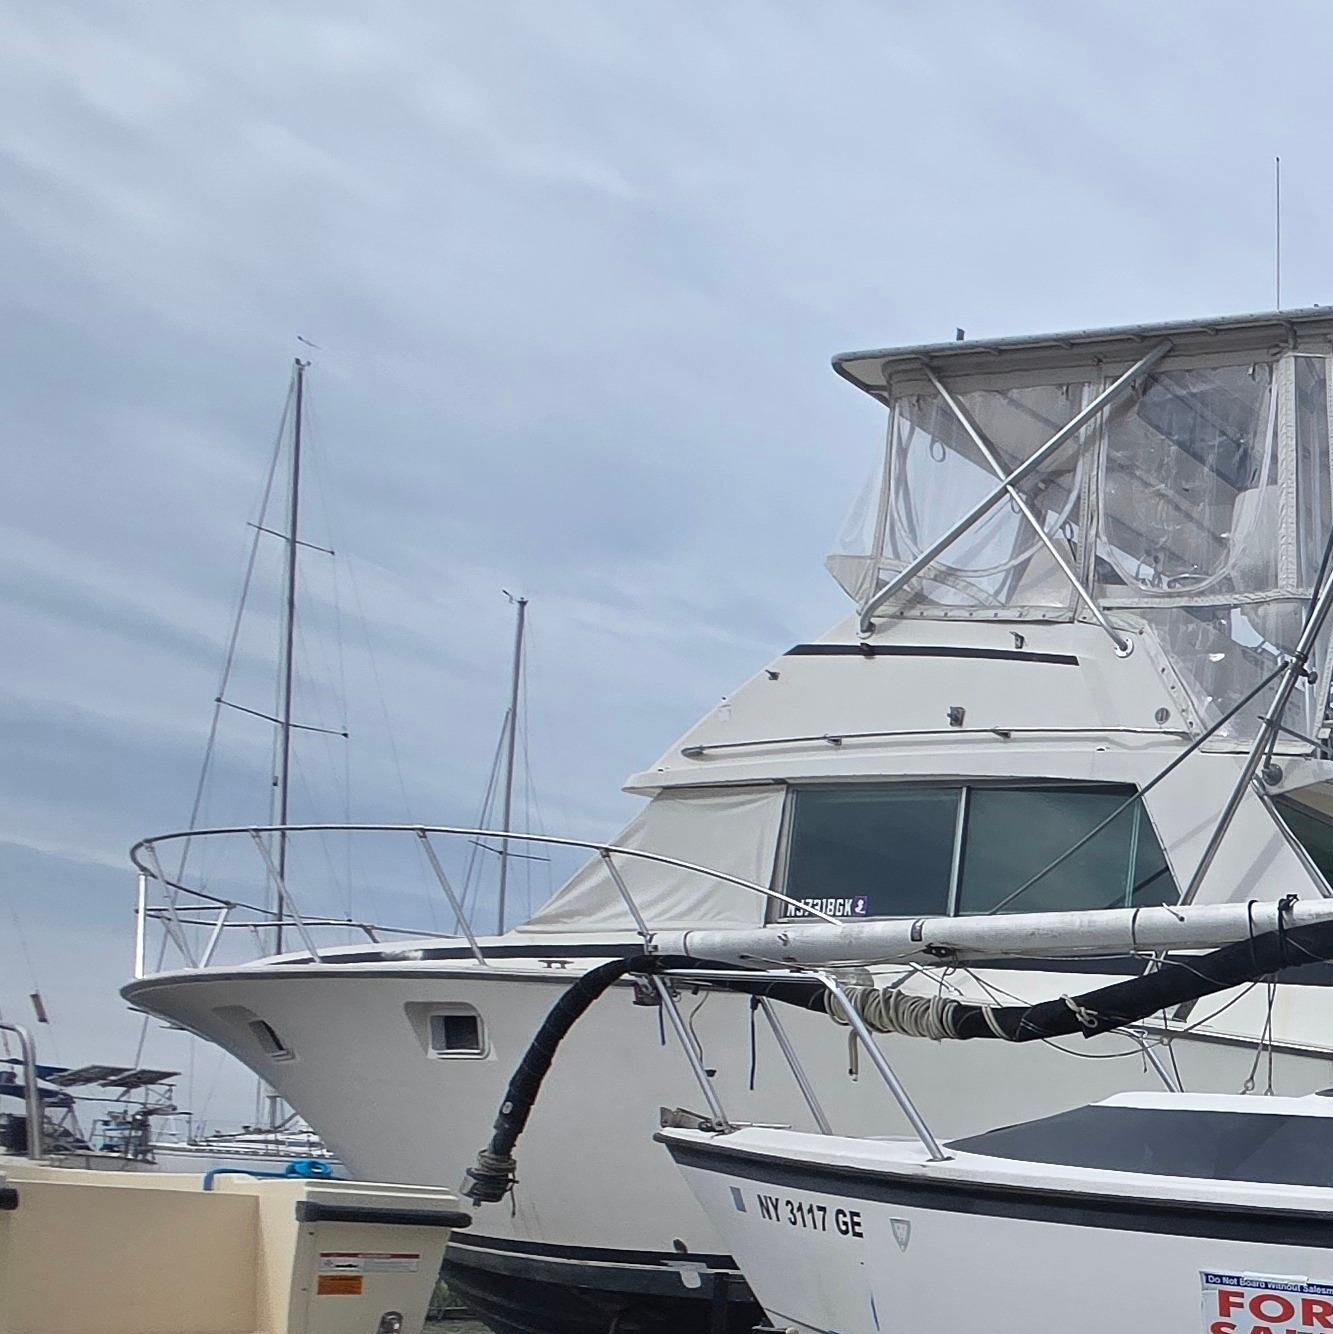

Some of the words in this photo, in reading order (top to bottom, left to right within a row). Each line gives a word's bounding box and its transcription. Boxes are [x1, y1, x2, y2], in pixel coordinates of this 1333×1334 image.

[757, 1194, 781, 1222] NY
[785, 1200, 827, 1232] 3117
[835, 1208, 864, 1239] GE
[1207, 1275, 1221, 1284] Do
[1222, 1276, 1238, 1286] Not
